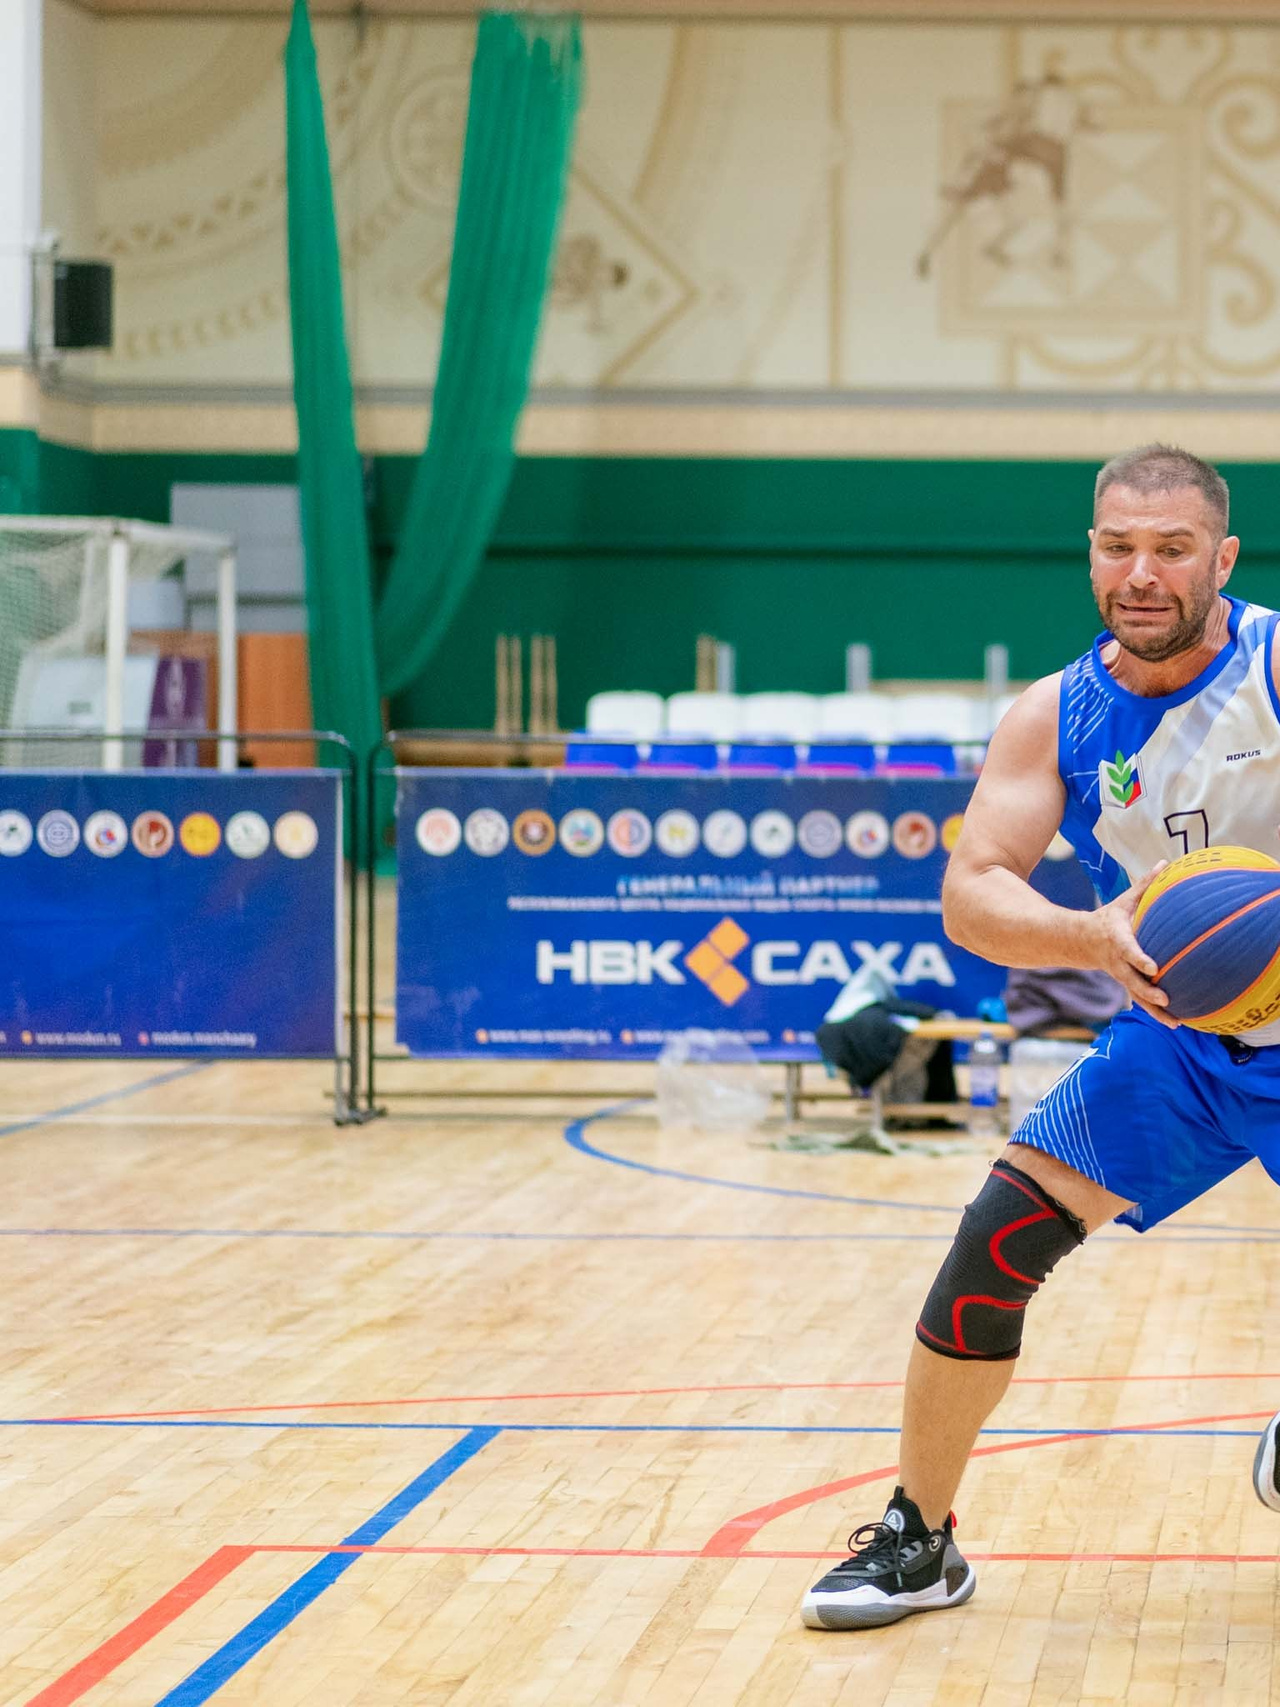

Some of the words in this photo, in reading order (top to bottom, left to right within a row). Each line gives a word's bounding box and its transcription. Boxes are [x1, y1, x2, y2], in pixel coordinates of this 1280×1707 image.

[1226, 749, 1261, 762] ROKUS
[536, 940, 686, 985] НВК
[751, 940, 956, 987] САХА
